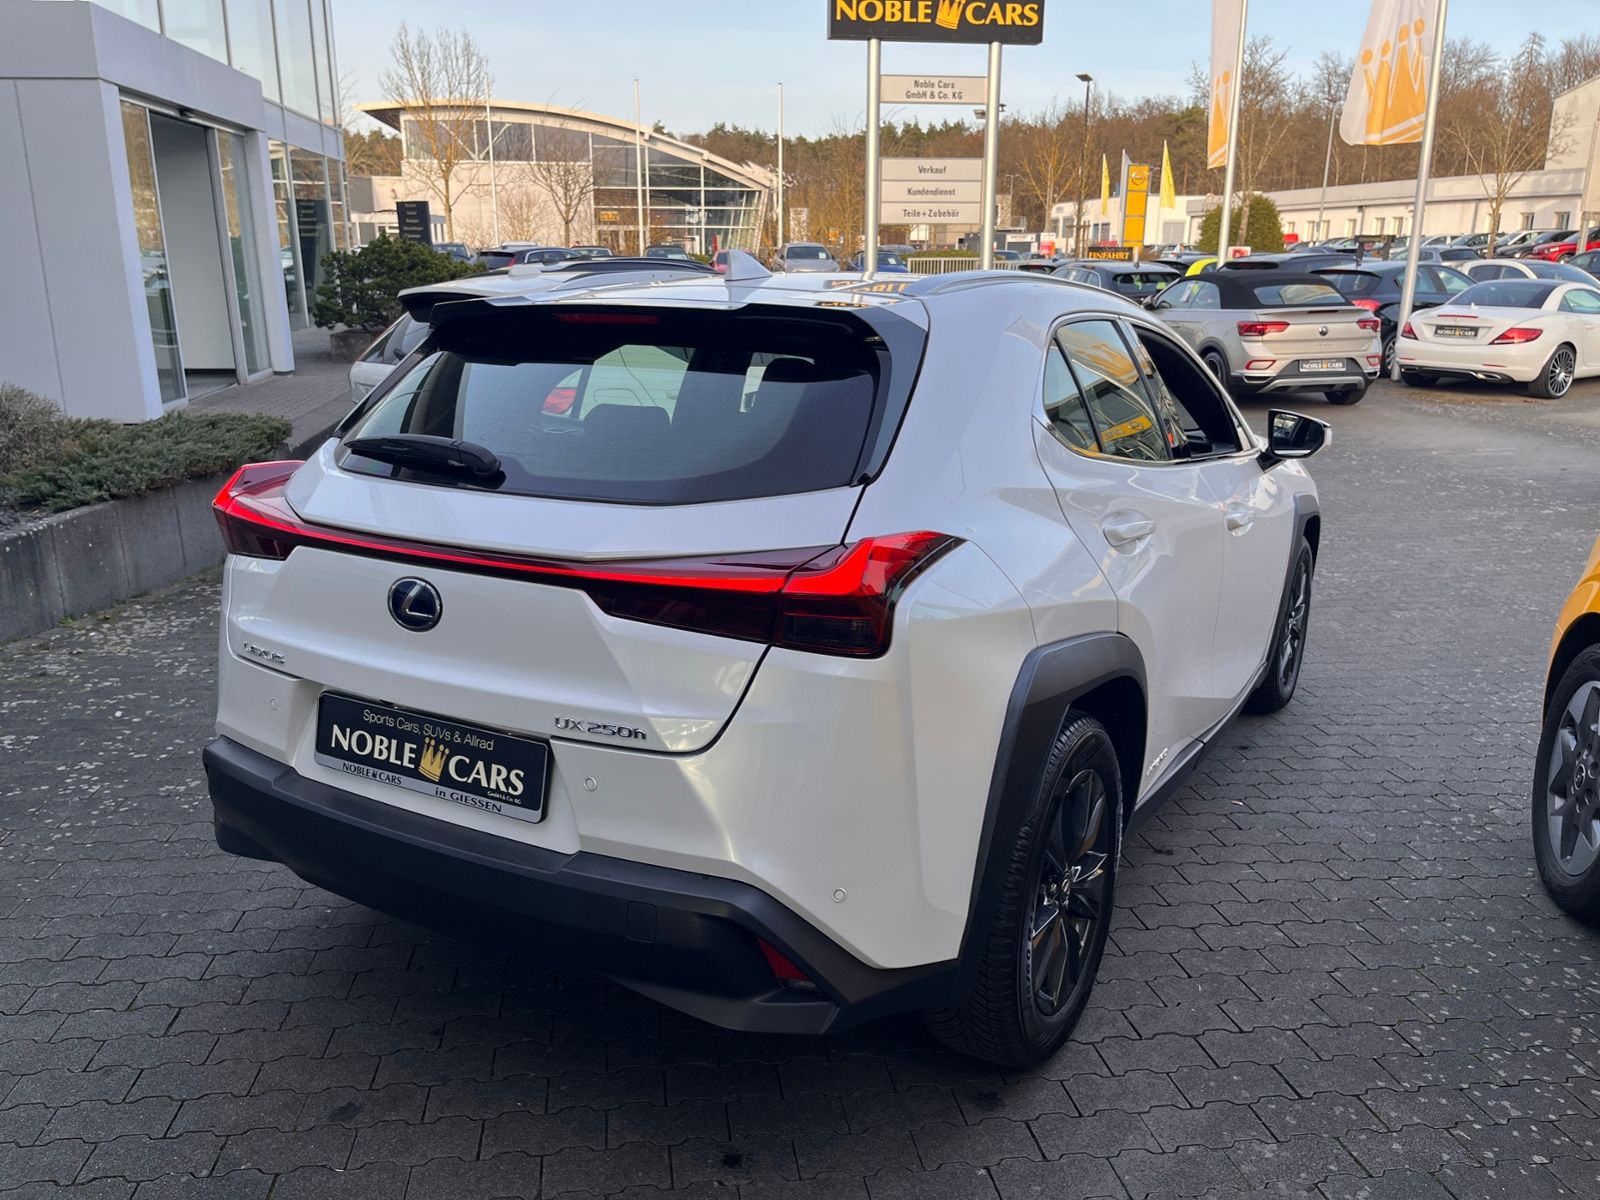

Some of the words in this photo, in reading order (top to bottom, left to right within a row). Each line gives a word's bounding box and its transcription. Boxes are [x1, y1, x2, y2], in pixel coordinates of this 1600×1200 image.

[836, 0, 931, 23] NOBLE
[965, 3, 1039, 26] CARS
[905, 91, 927, 99] GmbH
[929, 91, 935, 99] &
[937, 91, 950, 99] Co.
[952, 91, 963, 100] KG
[914, 80, 935, 88] Noble
[937, 80, 955, 89] Cars
[918, 166, 947, 174] Verkauf
[907, 188, 956, 196] Kundendienst
[1088, 251, 1129, 260] EINFAHRT
[363, 709, 394, 728] Sports
[396, 717, 421, 735] Cars,
[423, 723, 451, 740] SUVs
[453, 731, 462, 743] &
[464, 732, 495, 751] Allrad
[554, 715, 585, 732] UX
[587, 720, 647, 740] 250h
[331, 724, 417, 769] NOBLE
[448, 755, 525, 796] CARS
[342, 762, 371, 778] NOBLE
[378, 771, 402, 785] CARS
[435, 787, 446, 798] in
[450, 792, 502, 813] GIESSEN
